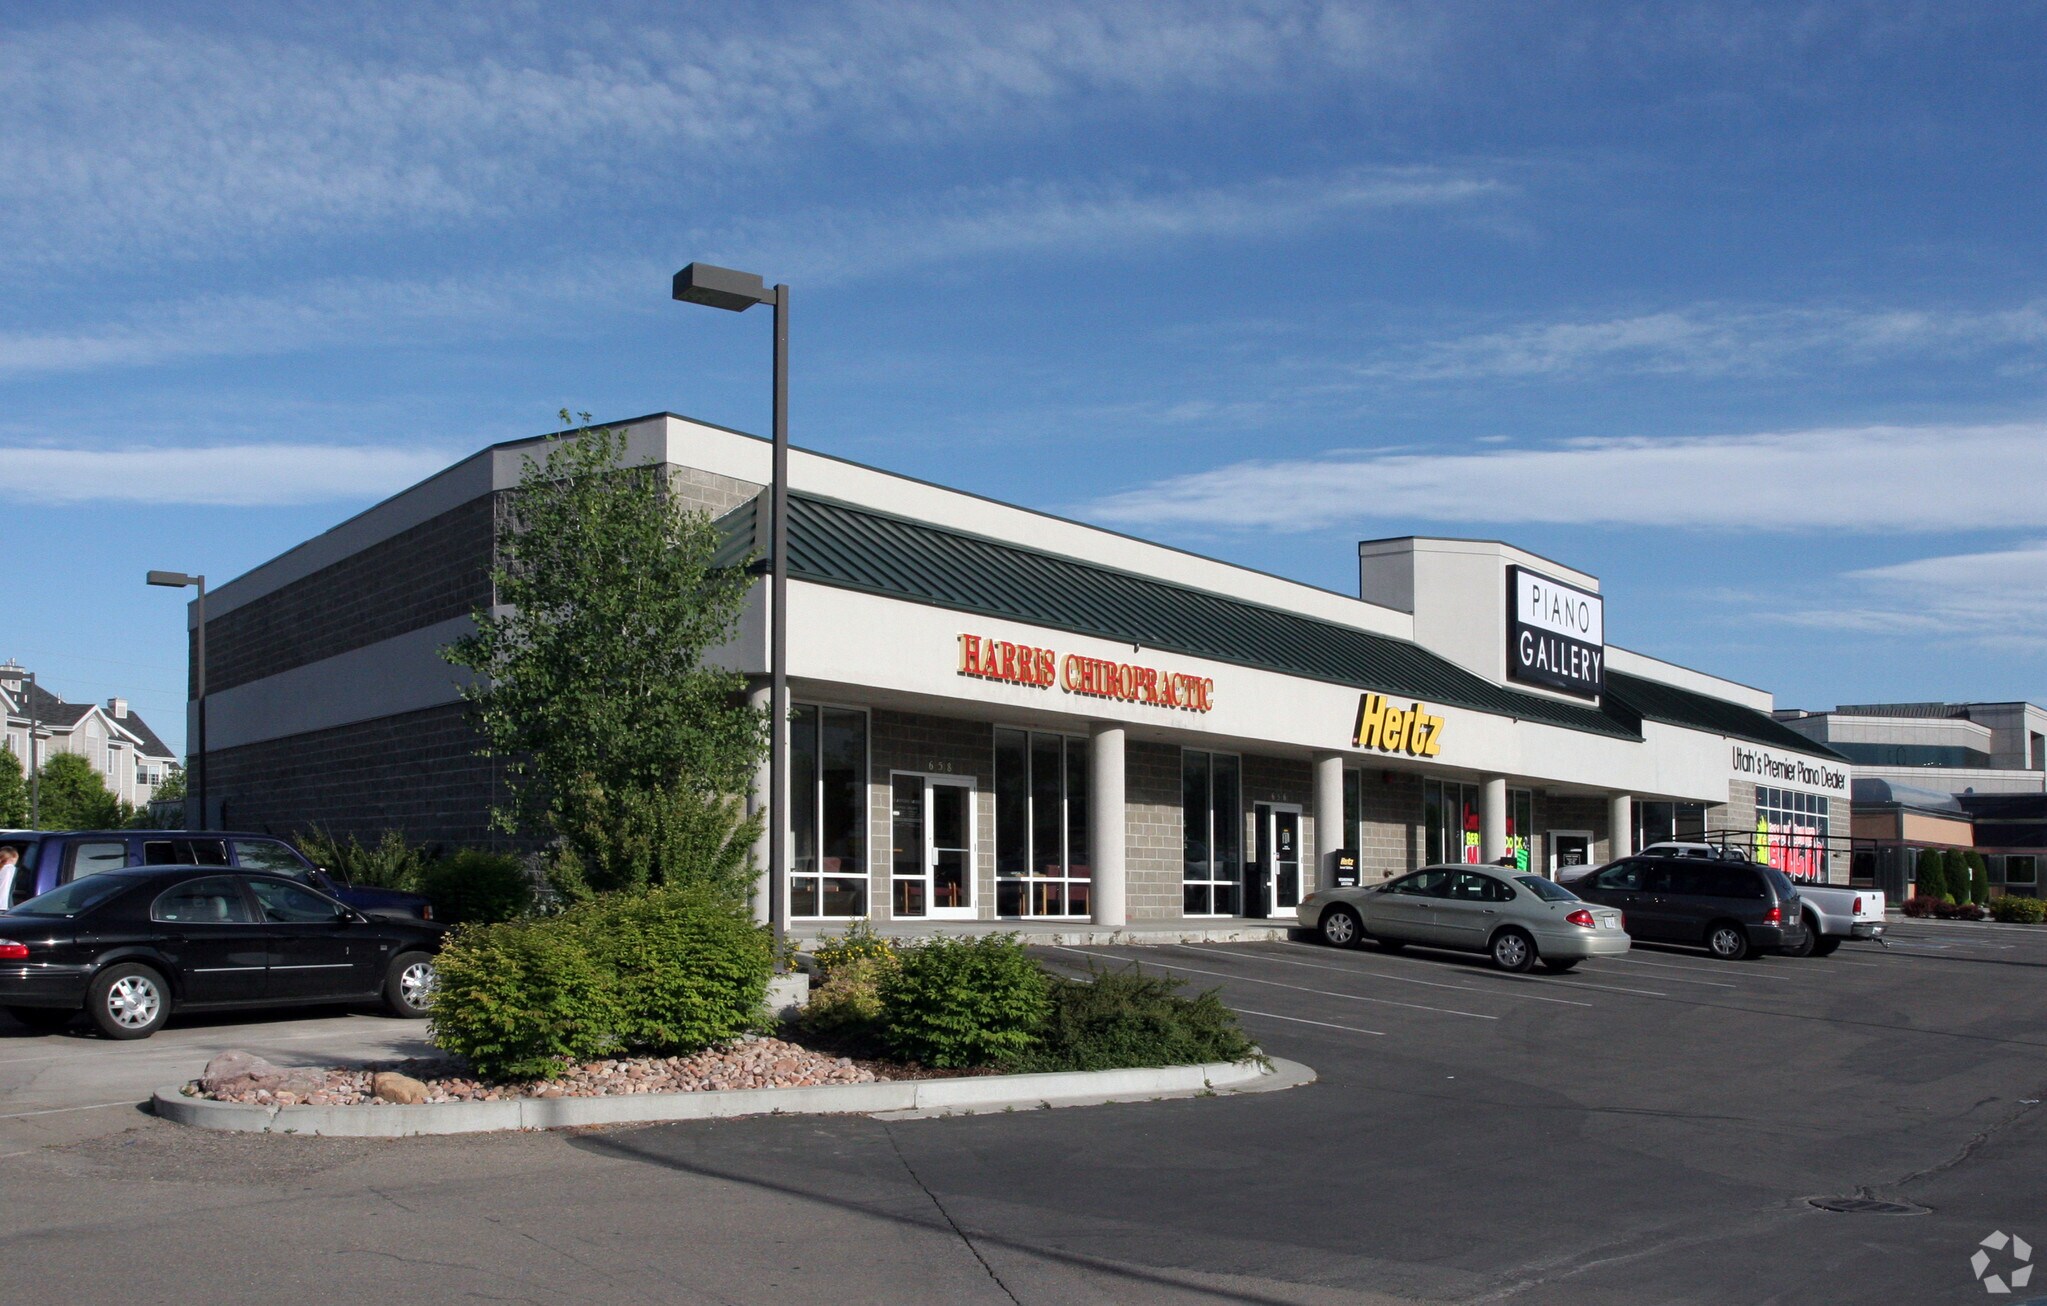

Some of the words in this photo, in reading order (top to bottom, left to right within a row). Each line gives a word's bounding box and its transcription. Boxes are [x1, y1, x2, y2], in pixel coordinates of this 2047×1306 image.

[1532, 584, 1590, 633] PIANO
[958, 633, 1056, 688] HARRIS
[1061, 653, 1214, 711] CHIROPRACTIC
[1520, 631, 1601, 684] GALLERY
[1354, 692, 1445, 756] Hertz
[928, 760, 953, 772] 658
[1732, 746, 1762, 775] Utah's
[1764, 753, 1796, 781] Premier
[1797, 761, 1820, 785] Piano
[1821, 766, 1846, 790] Dealer
